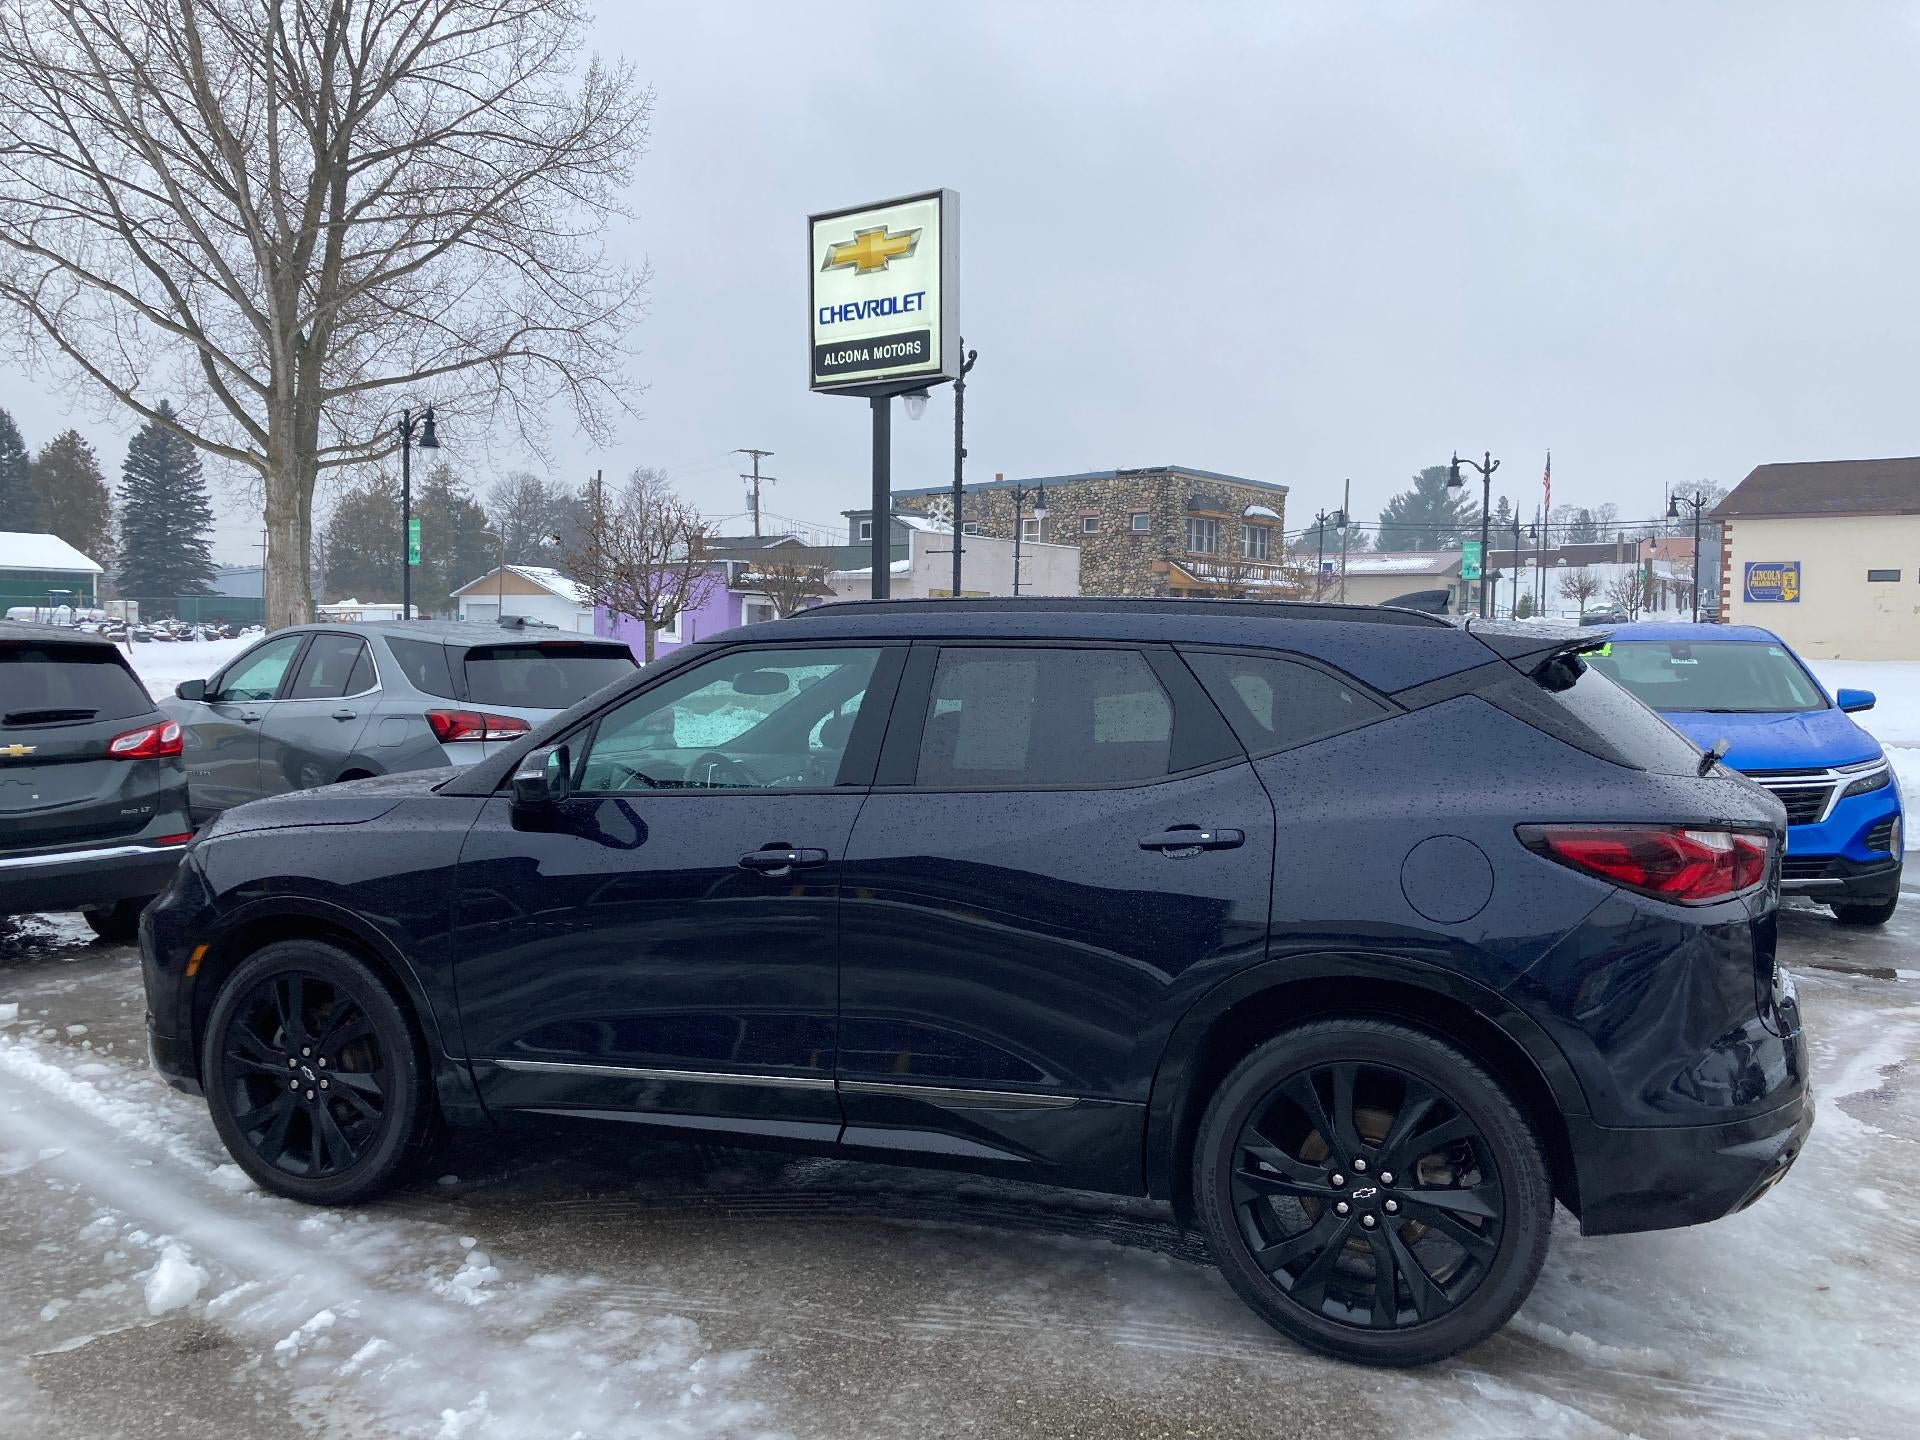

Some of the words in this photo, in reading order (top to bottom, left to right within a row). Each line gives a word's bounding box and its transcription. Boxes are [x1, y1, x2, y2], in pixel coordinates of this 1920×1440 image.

[819, 291, 926, 326] CHEVROLET
[824, 348, 869, 366] ALCONA
[873, 340, 921, 360] MOTORS
[1751, 570, 1781, 581] LINCOLN
